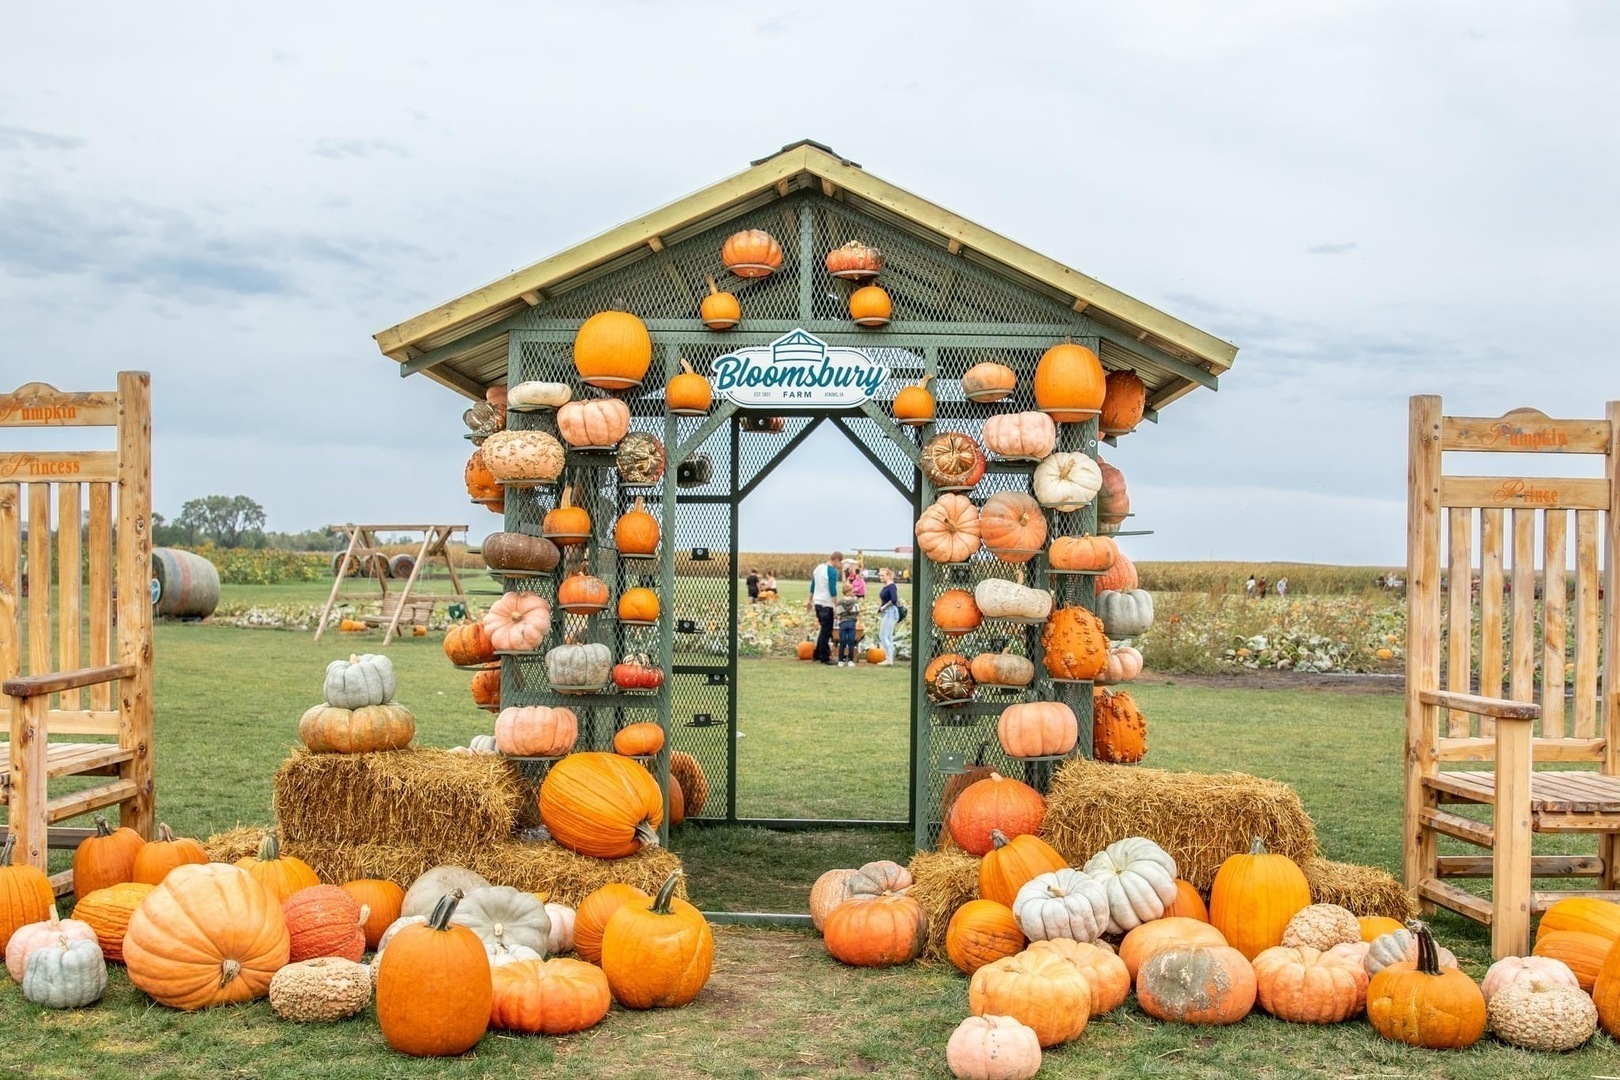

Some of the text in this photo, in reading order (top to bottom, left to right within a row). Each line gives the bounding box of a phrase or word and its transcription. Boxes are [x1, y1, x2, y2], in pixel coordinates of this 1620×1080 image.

[714, 356, 889, 397] Bloomsbury
[0, 399, 77, 424] Pumpkin
[1481, 422, 1568, 450] Pumpkin
[1, 453, 80, 477] Princess
[1493, 479, 1559, 504] Prince
